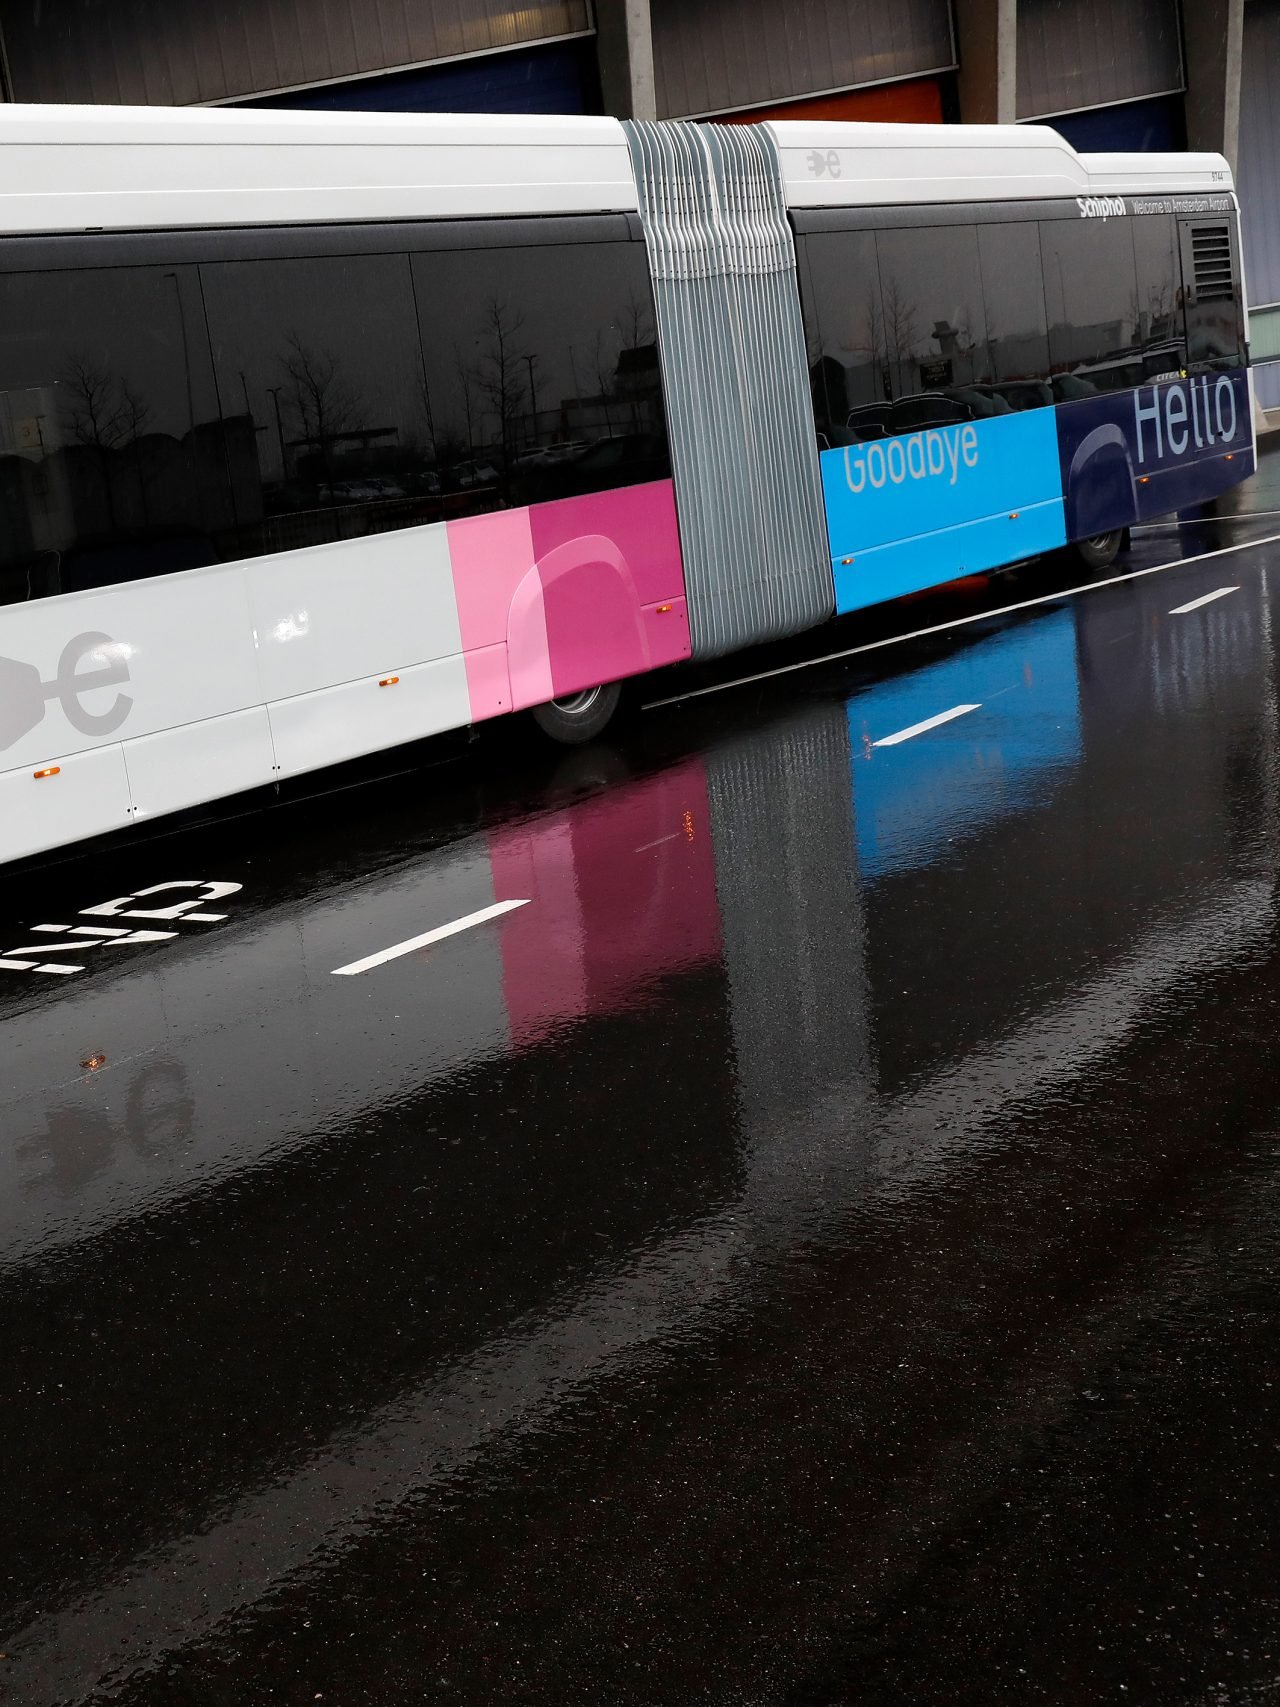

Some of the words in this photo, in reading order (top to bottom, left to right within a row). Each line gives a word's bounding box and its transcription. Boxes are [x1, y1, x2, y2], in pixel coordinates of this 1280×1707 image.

[1076, 196, 1126, 222] Schiphol
[1132, 200, 1164, 215] Welcome
[1172, 197, 1209, 214] Amsterdam
[1209, 197, 1230, 213] Airport
[1134, 375, 1236, 463] Hello
[843, 425, 979, 494] Goodbye
